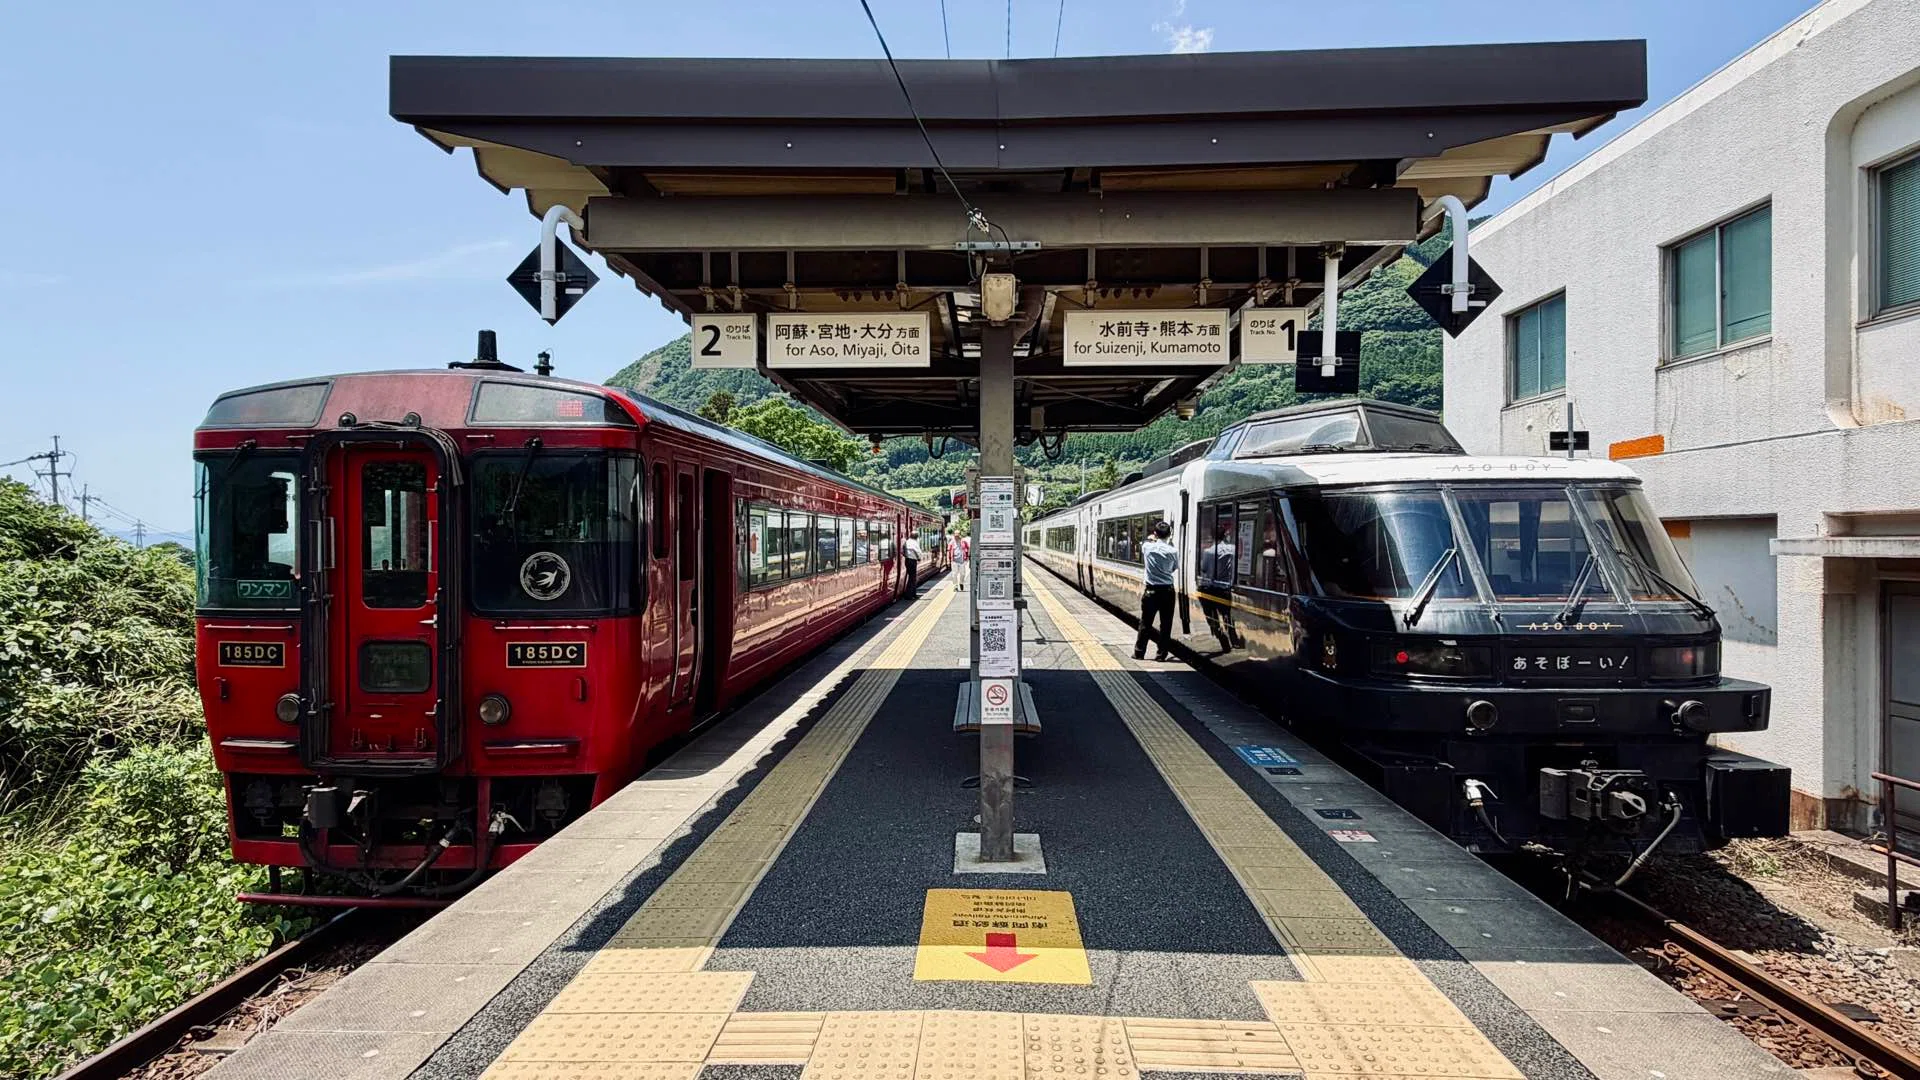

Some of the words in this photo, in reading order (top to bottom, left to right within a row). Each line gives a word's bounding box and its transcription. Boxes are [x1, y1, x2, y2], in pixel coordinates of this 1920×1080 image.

[725, 325, 751, 333] のりば
[1250, 320, 1276, 328] のりば
[701, 324, 722, 356] 2
[1280, 319, 1295, 351] 1
[786, 344, 806, 356] for
[809, 344, 838, 358] Aso,
[843, 343, 887, 359] Miyaji,
[891, 341, 920, 356] Ōita
[1073, 341, 1092, 354] for
[1095, 341, 1146, 357] Suizenji,
[1151, 341, 1221, 354] Kumamoto
[1451, 463, 1492, 472] ASO
[1510, 463, 1550, 472] BOY
[239, 582, 287, 596] ワンマン
[1529, 622, 1563, 631] ASO
[1574, 622, 1611, 631] BOY
[225, 645, 277, 659] 185DC
[515, 645, 578, 659] 185DC
